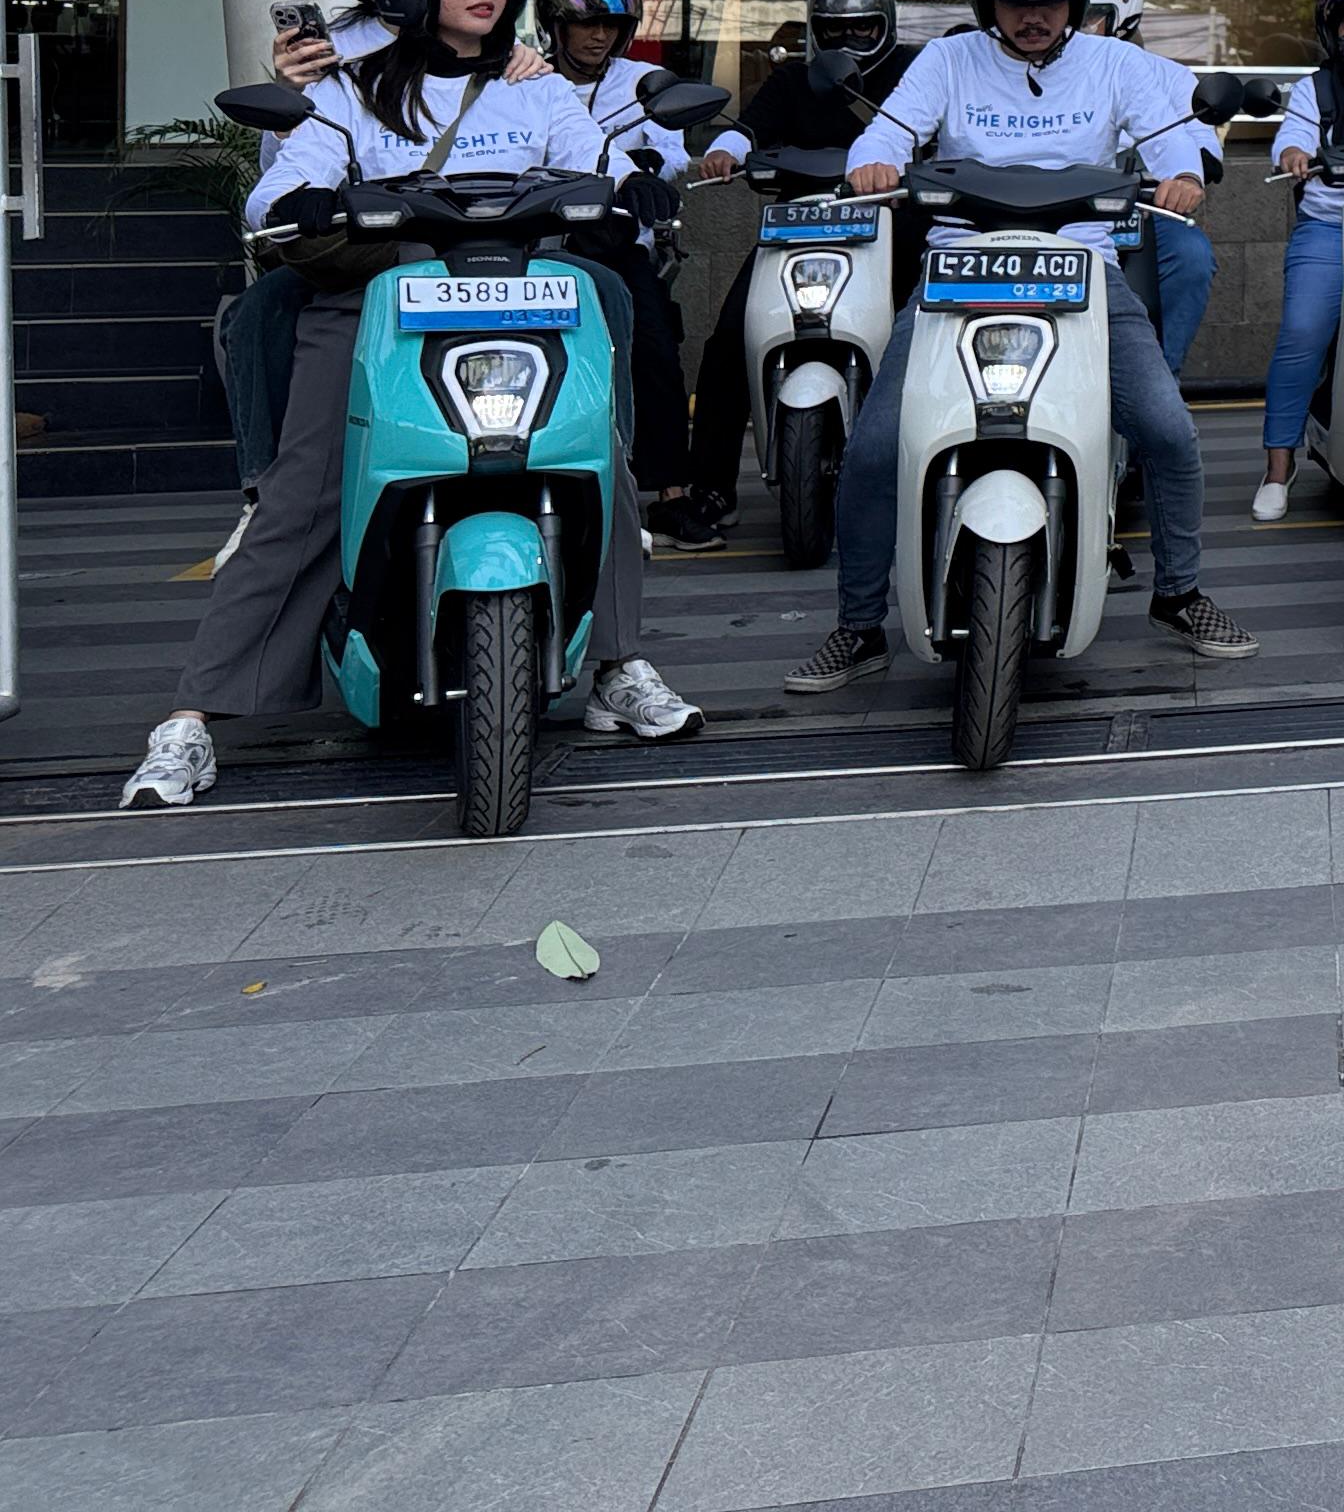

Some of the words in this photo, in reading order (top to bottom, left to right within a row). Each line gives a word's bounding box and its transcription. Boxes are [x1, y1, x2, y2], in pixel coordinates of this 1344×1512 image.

[966, 111, 1001, 127] THE
[1007, 114, 1065, 128] RIGHT
[1072, 111, 1095, 125] EV
[508, 131, 533, 145] EV
[767, 207, 776, 223] L
[990, 234, 1041, 242] HONDA
[467, 255, 511, 263] HONDA
[960, 255, 1021, 276] 2140
[1032, 255, 1078, 276] ACD
[406, 282, 421, 303] L
[436, 281, 509, 304] 3589
[524, 280, 569, 302] DAV
